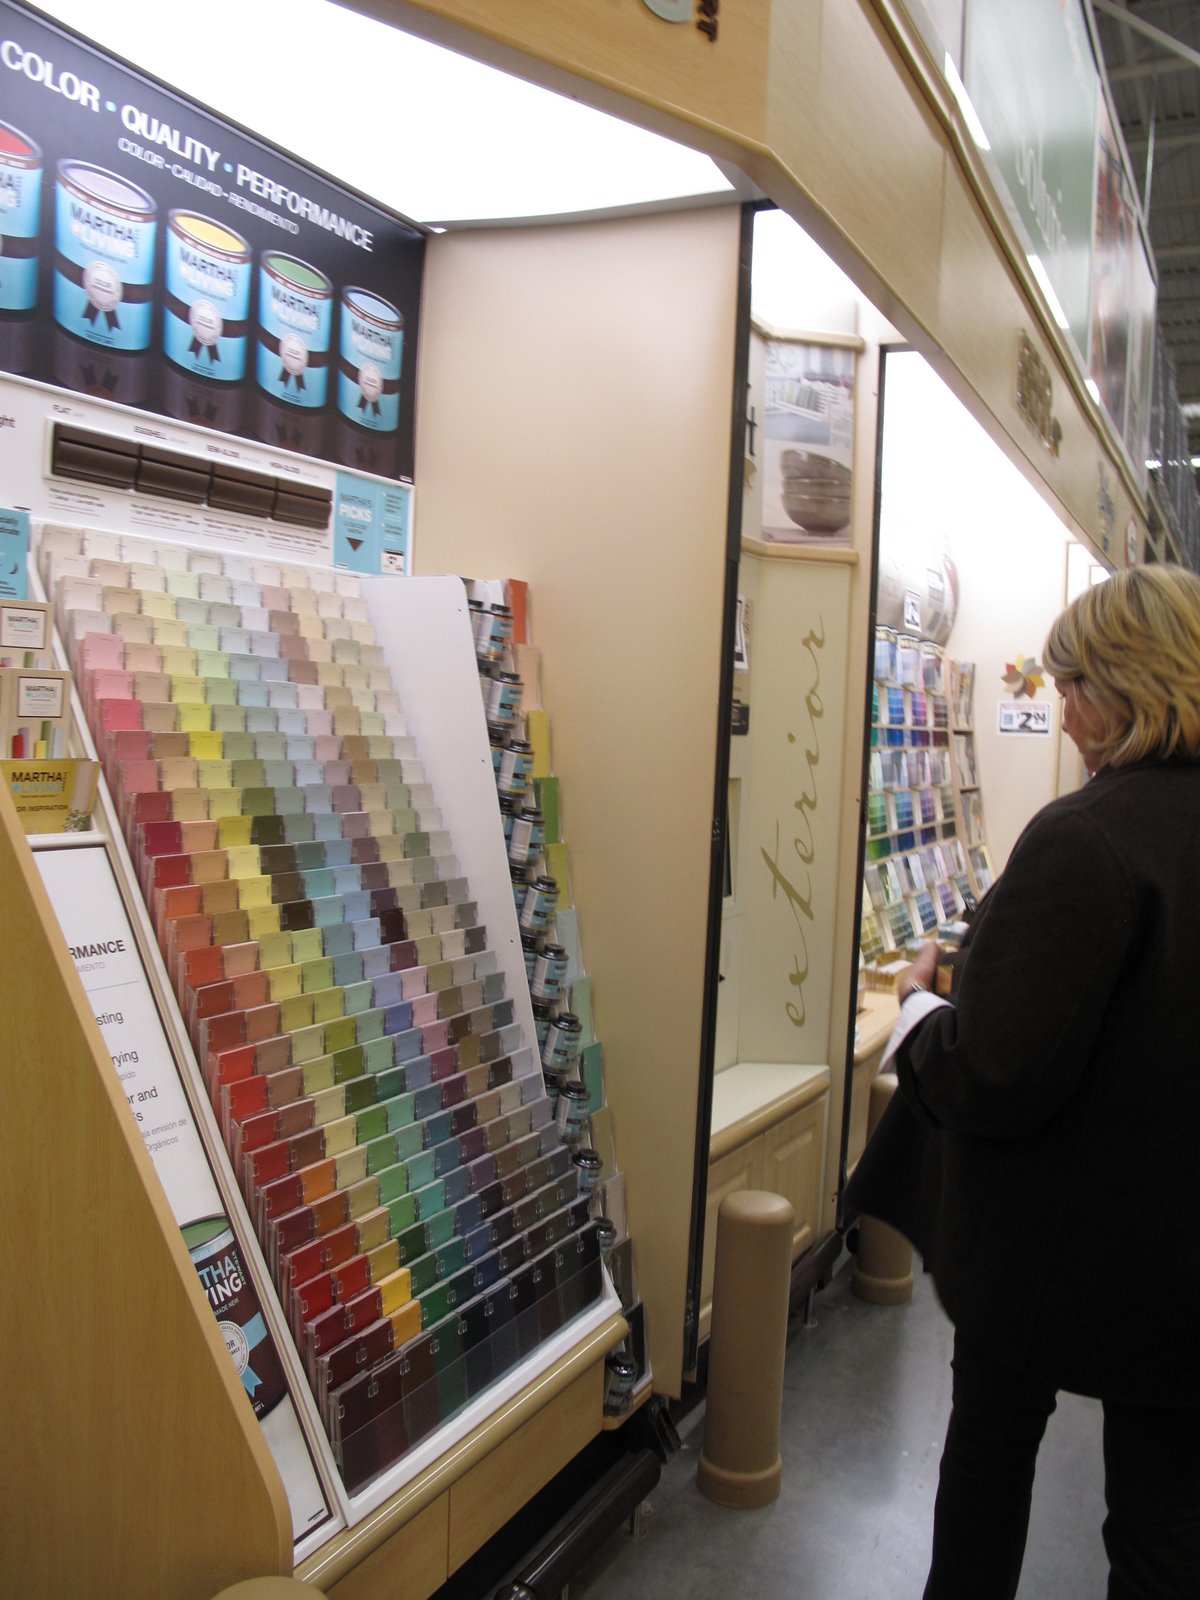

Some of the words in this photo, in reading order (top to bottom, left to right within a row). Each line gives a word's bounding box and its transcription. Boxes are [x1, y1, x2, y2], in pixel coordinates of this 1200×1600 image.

[1, 40, 101, 113] COLOR
[121, 104, 221, 173] QUALITY
[236, 163, 374, 253] PERFORMANCE
[118, 137, 164, 169] COLOR
[70, 202, 134, 242] MARTHA
[180, 246, 233, 281] MARTHA
[12, 771, 62, 783] MARTHA
[29, 804, 69, 812] INSPIRATION
[761, 613, 824, 1027] exterior
[138, 1086, 158, 1103] and
[178, 1118, 187, 1128] de
